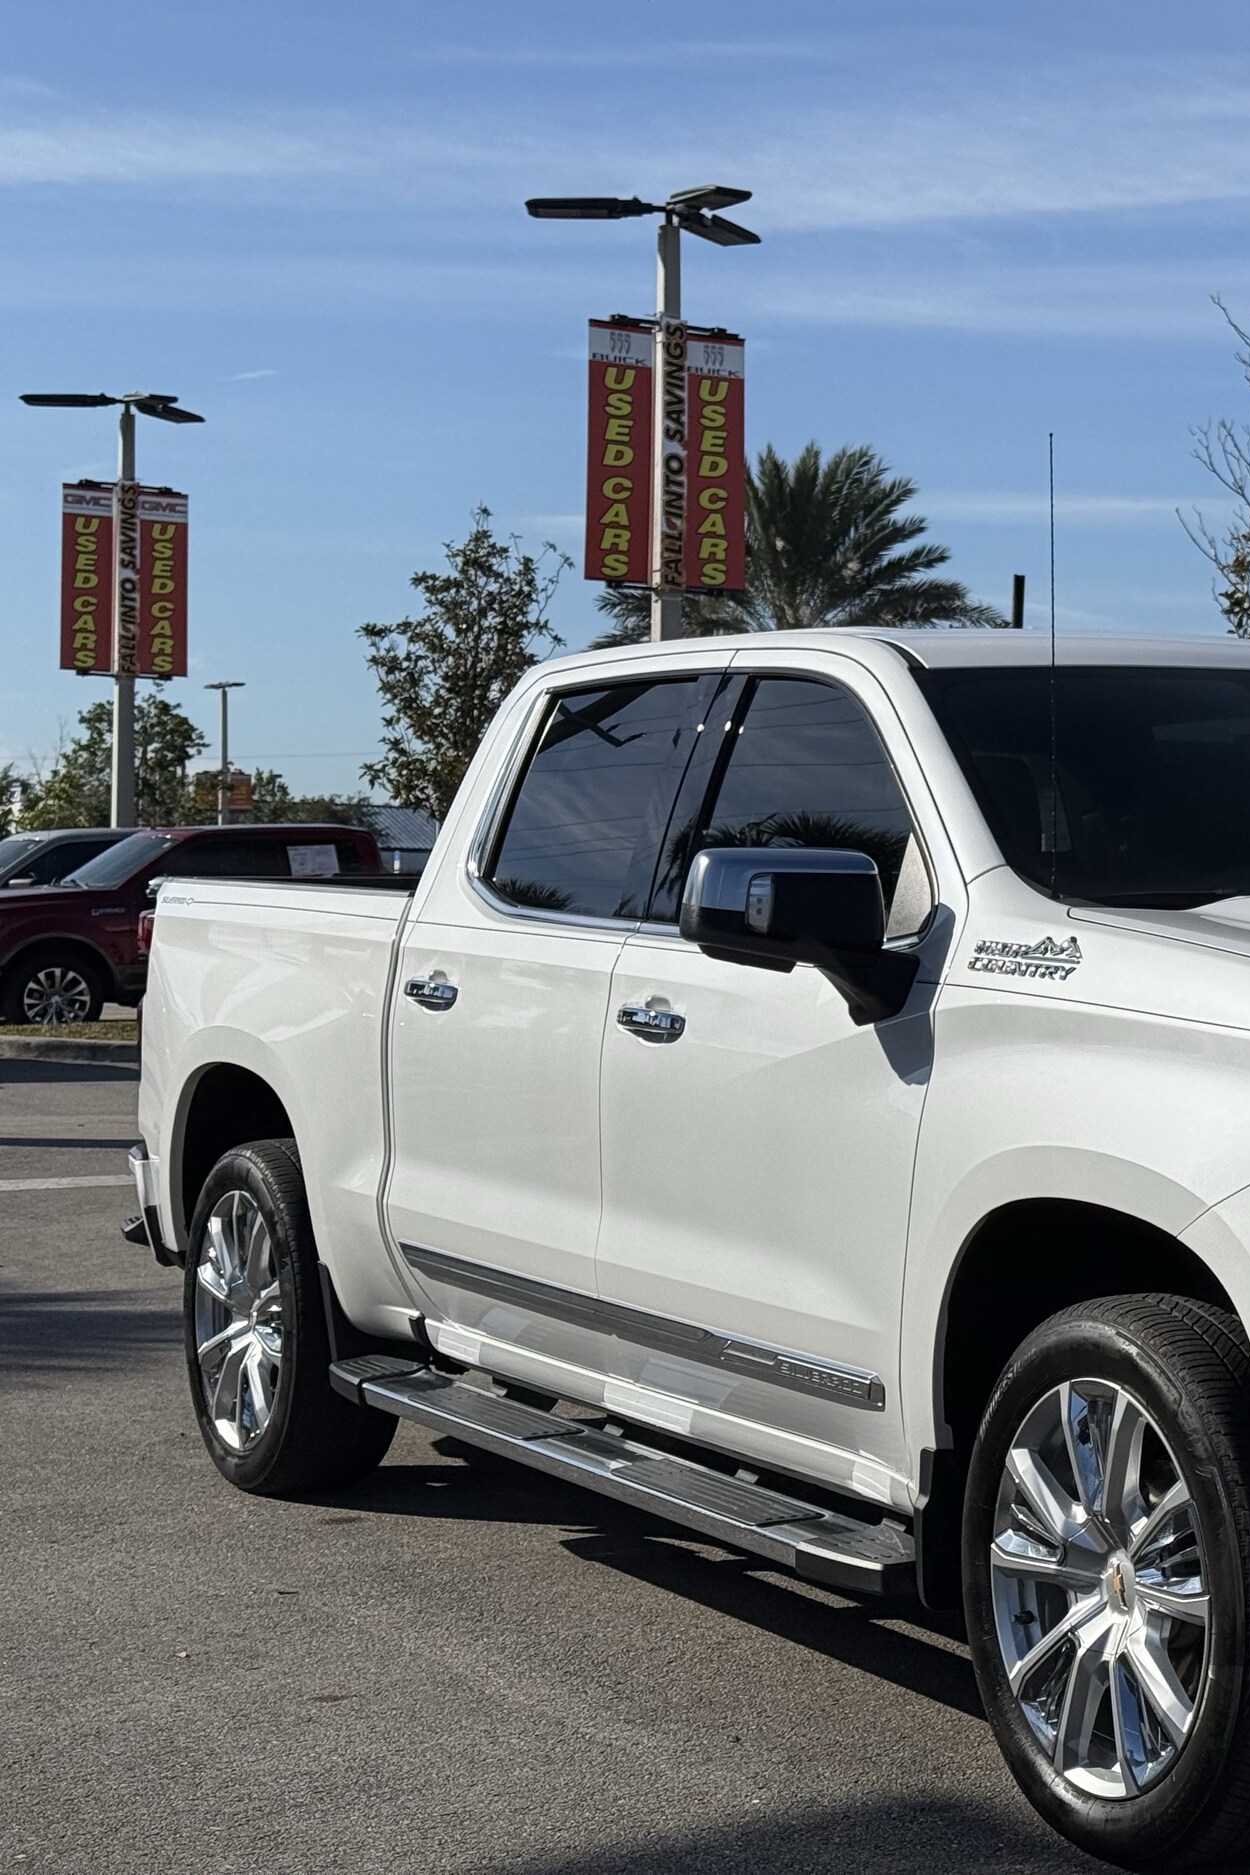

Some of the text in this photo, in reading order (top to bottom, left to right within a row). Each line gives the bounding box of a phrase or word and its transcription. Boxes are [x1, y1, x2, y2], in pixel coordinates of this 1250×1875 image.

[592, 352, 646, 366] BUICK
[687, 365, 741, 379] BUICK
[599, 366, 636, 578] USED CARS
[662, 321, 687, 590] FALL INTO SAVINGS
[697, 379, 730, 587] USED CARS
[64, 493, 112, 508] GMC
[119, 483, 138, 571] SAVINGS
[141, 500, 187, 514] GMC
[73, 516, 100, 590] USED
[151, 523, 176, 595] USED
[72, 595, 98, 669] CARS
[119, 577, 137, 625] INTO
[150, 600, 175, 674] CARS
